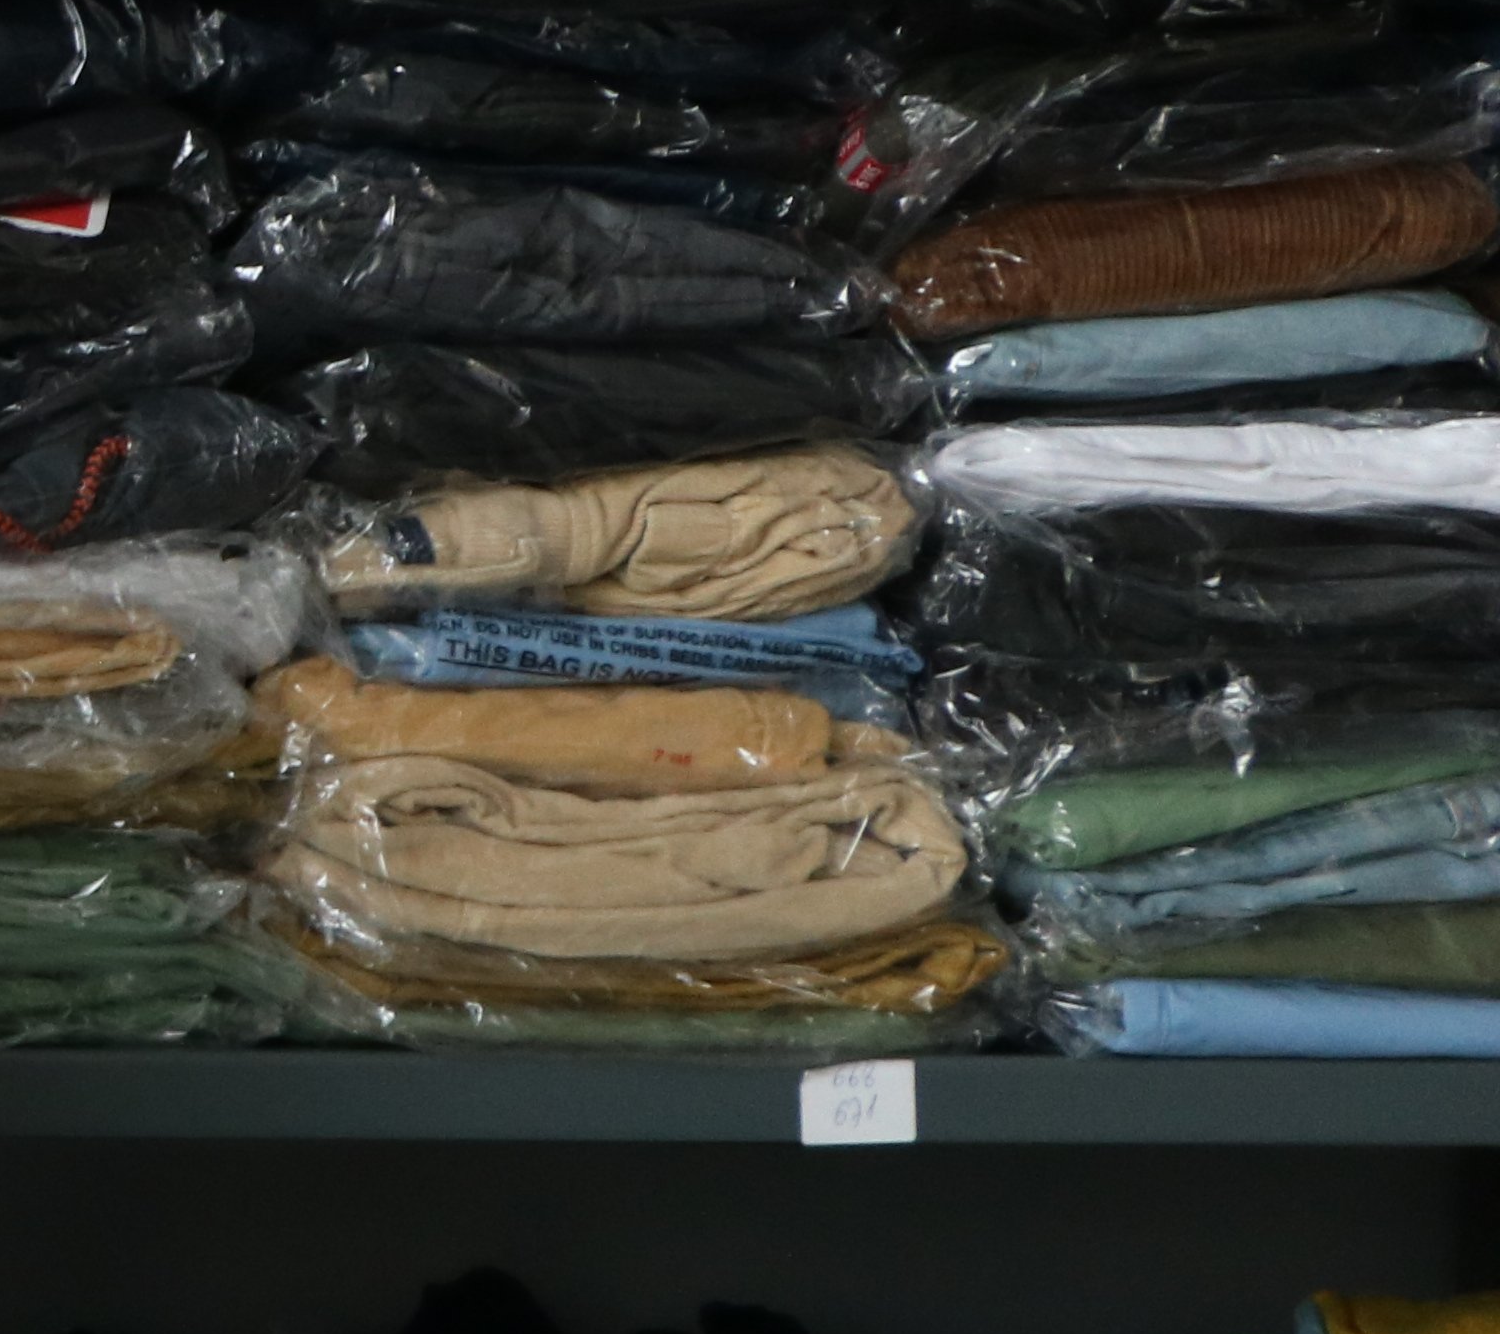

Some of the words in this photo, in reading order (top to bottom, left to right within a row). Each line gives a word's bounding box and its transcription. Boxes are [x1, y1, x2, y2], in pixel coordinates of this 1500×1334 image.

[507, 624, 542, 641] NOT
[551, 630, 582, 647] USE
[589, 636, 605, 651] IN
[446, 638, 510, 664] THIS
[520, 650, 581, 677] BAG
[589, 662, 614, 679] IS
